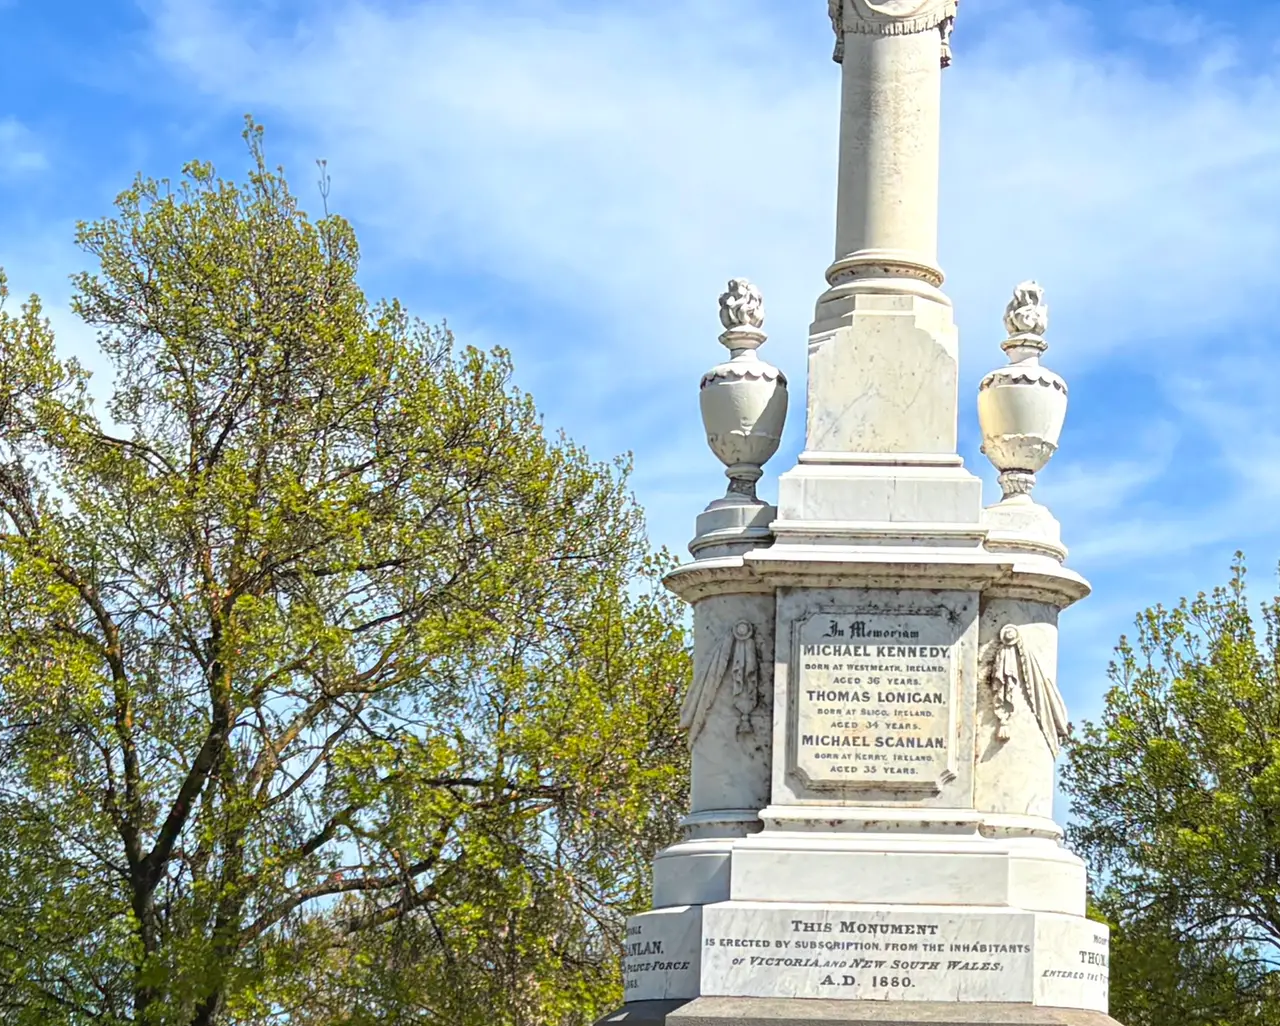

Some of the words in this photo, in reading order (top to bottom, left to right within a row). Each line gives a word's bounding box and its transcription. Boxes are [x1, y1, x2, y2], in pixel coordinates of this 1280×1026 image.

[822, 620, 844, 638] In
[849, 619, 920, 639] Memoriam
[803, 645, 870, 657] MICHAEL
[867, 677, 880, 685] 36
[887, 678, 922, 686] YEARS.
[806, 690, 871, 702] THOMAS
[885, 722, 921, 730] YEARS.
[802, 735, 870, 747] MICHAEL
[883, 767, 919, 775] YEARS.
[791, 920, 832, 933] THIS
[839, 921, 938, 935] MONUMENT
[705, 938, 716, 946] IS
[719, 938, 770, 948] ERECTED
[775, 940, 791, 949] BY
[885, 943, 918, 951] FROM
[922, 943, 945, 952] THE
[950, 943, 1031, 953] INHABITANTS
[732, 957, 745, 966] OF
[823, 960, 847, 968] AND
[849, 958, 886, 969] NEW
[890, 960, 940, 970] SOUTH
[1042, 969, 1084, 980] ENTERED
[820, 975, 861, 986] A.D.
[872, 976, 915, 988] 1880.
